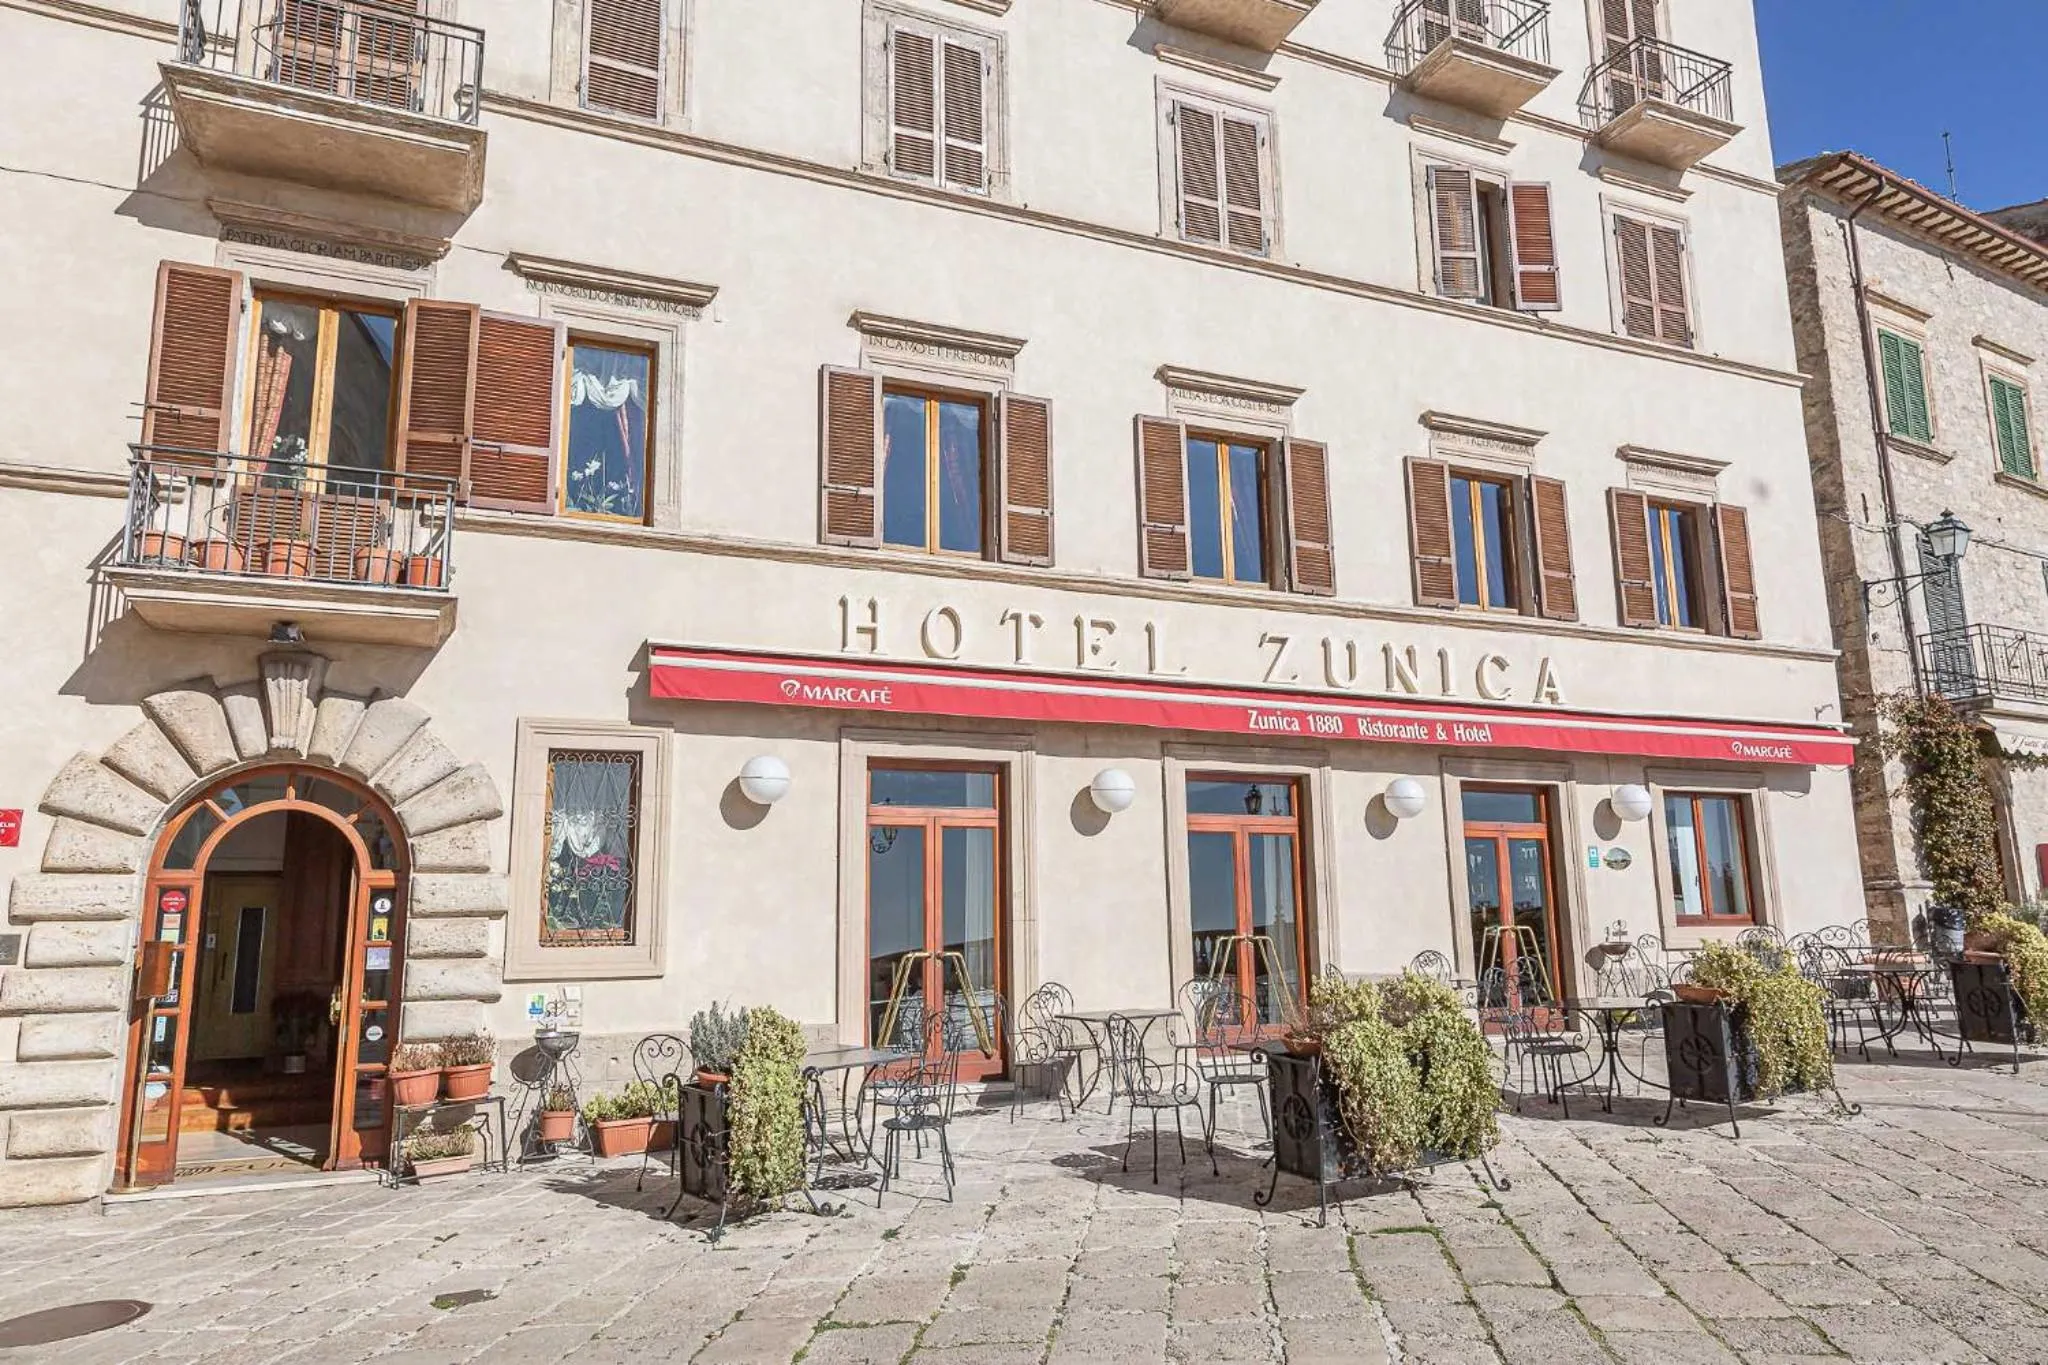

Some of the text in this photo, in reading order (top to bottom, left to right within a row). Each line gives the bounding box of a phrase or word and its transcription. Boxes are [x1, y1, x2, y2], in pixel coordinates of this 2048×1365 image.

[837, 593, 1568, 705] HOTEL ZUNICA
[802, 684, 892, 704] MARCAFÈ
[1248, 709, 1492, 743] Zunica 1880 Ristorante & Hotel
